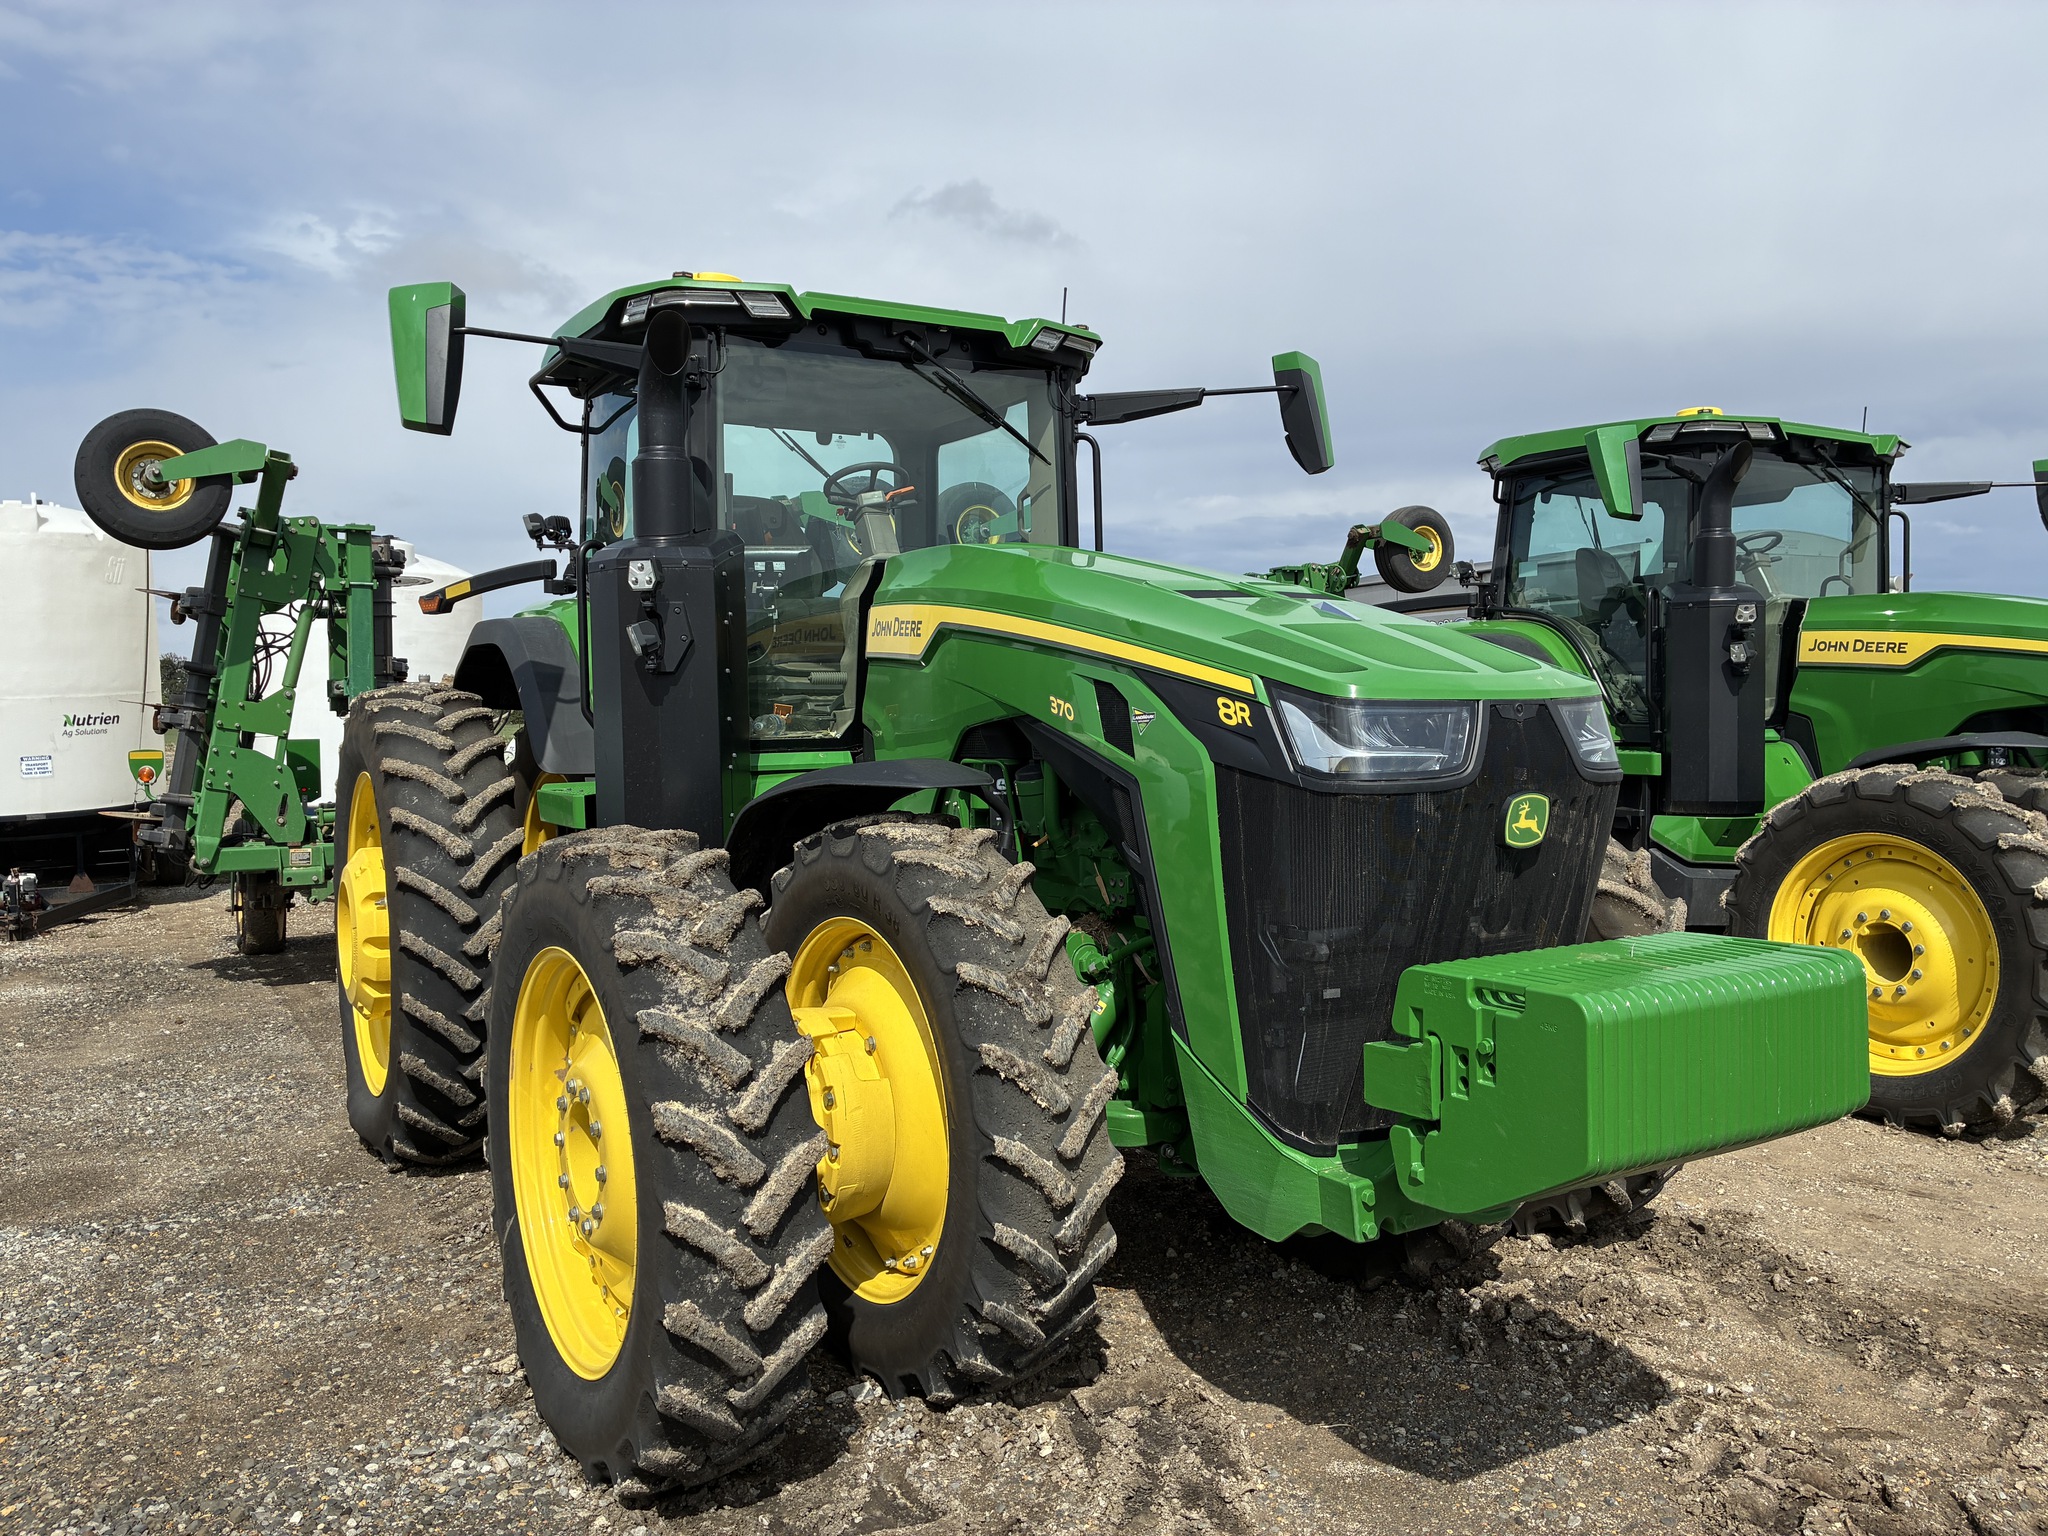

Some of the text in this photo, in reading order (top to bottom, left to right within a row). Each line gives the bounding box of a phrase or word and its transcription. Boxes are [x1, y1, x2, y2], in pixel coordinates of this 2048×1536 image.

[872, 617, 923, 637] JOHN DEERE
[1808, 639, 1909, 653] JOHN DEERE
[1049, 695, 1075, 721] 370
[1216, 696, 1254, 728] 8R
[63, 712, 120, 727] Nutrien
[62, 728, 108, 738] Ag Solutions
